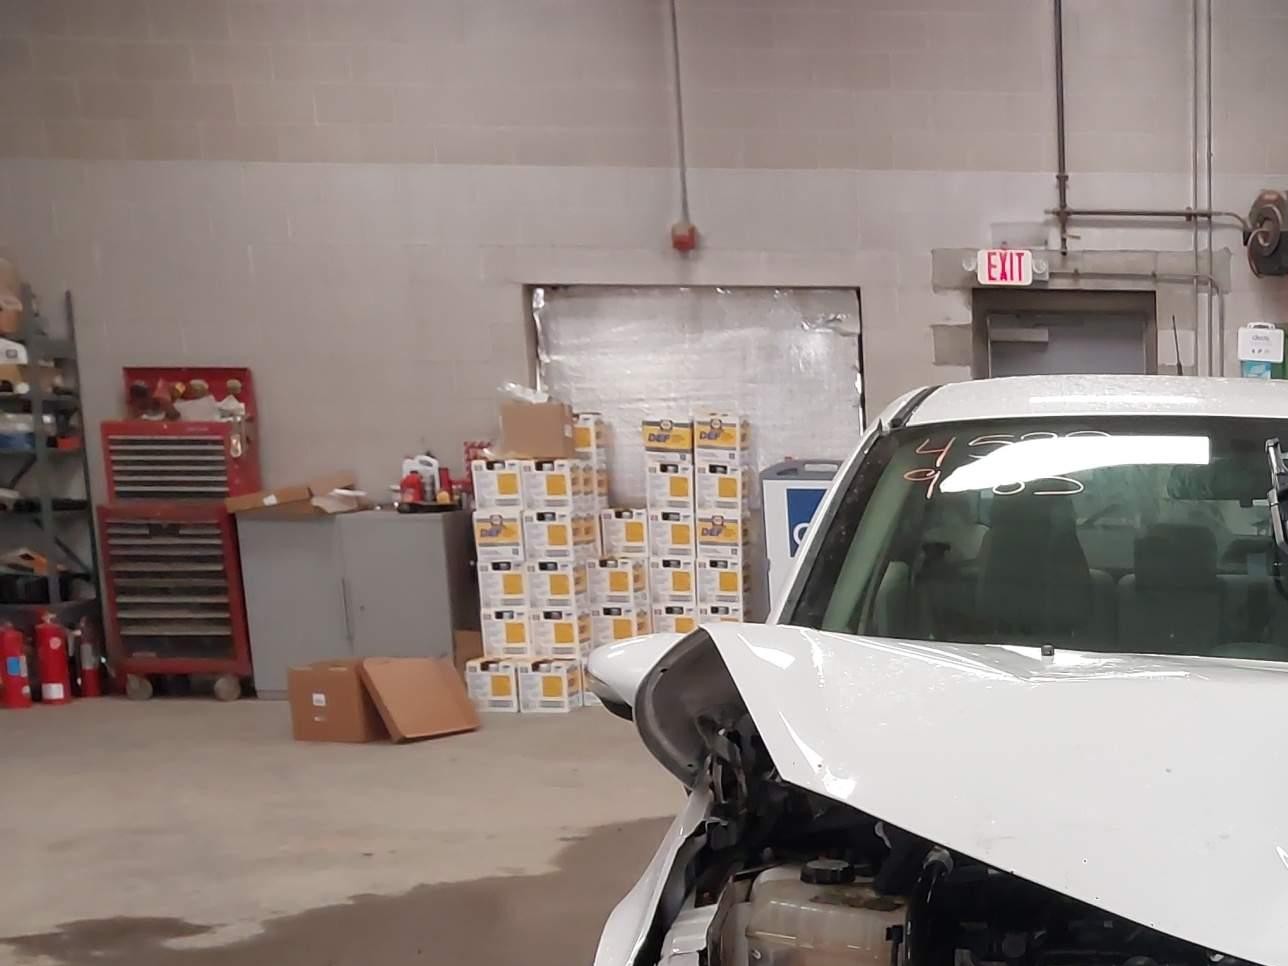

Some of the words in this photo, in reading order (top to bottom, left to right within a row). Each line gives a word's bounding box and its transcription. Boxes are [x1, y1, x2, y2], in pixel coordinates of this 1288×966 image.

[987, 251, 1025, 281] EXIT
[647, 432, 672, 443] DEF
[699, 430, 721, 441] DEF
[480, 527, 502, 537] DEF
[701, 527, 722, 537] DEF
